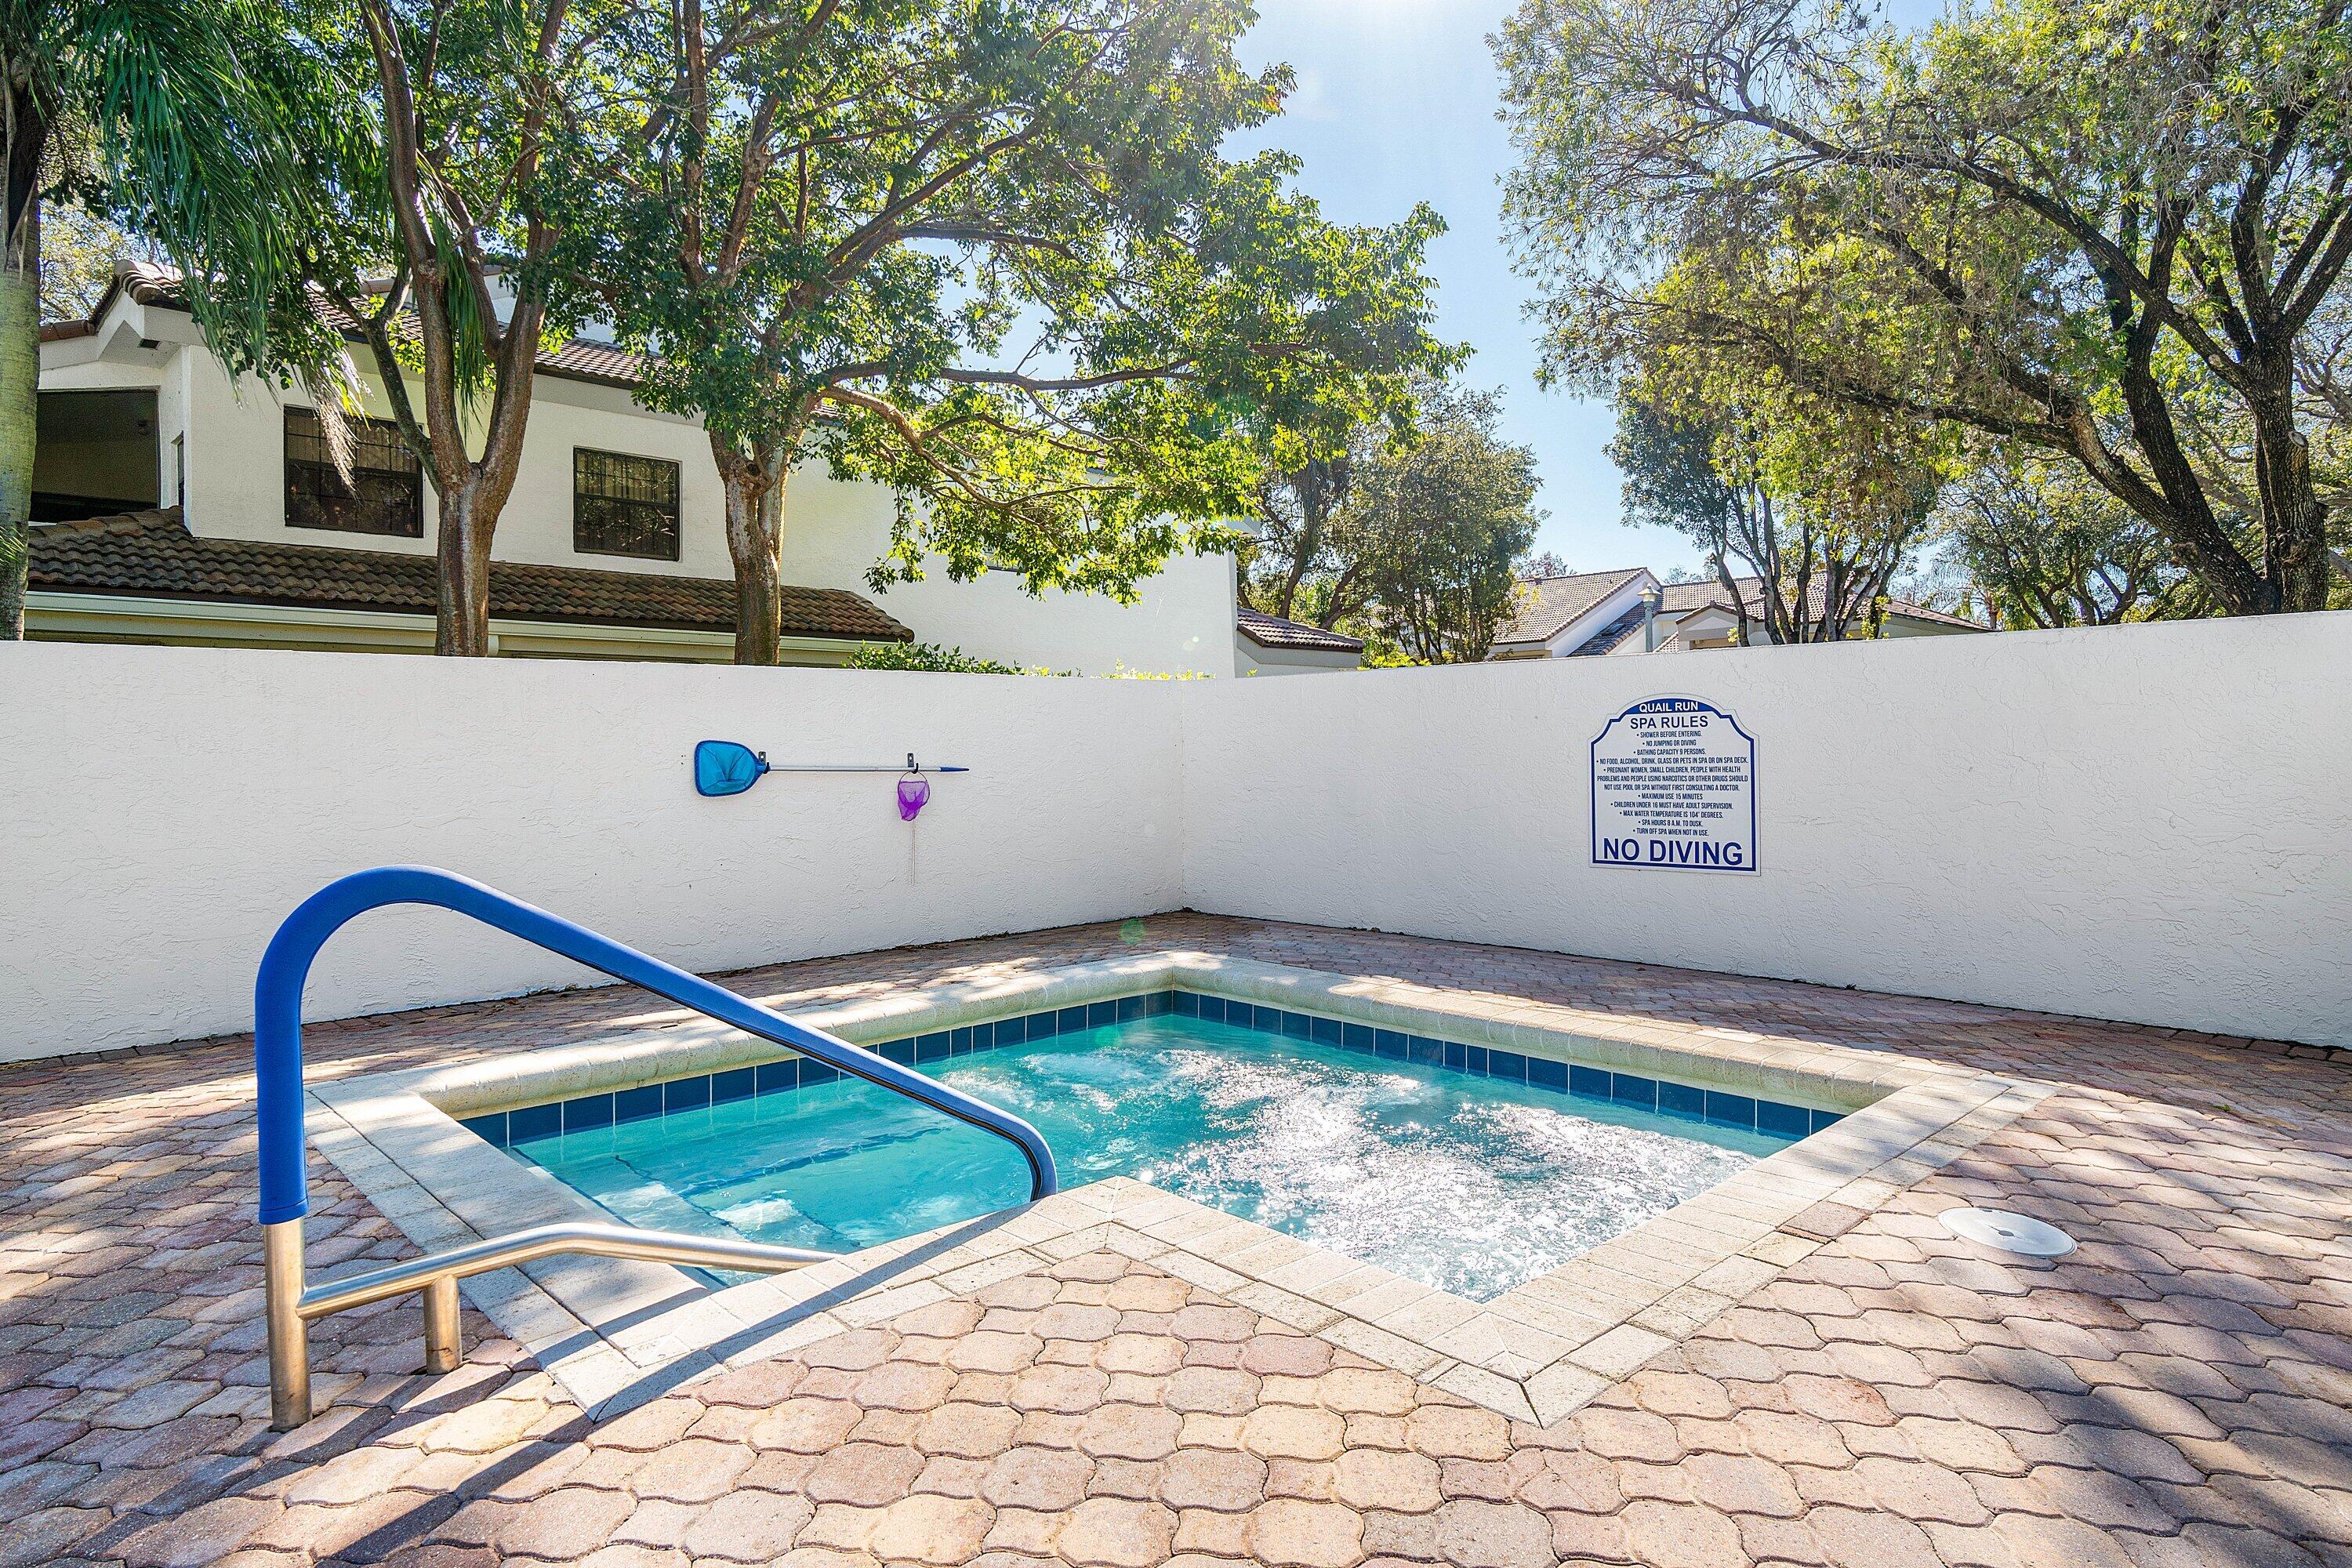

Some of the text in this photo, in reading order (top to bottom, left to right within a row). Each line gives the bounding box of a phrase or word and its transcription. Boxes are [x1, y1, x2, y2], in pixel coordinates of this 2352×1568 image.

[1639, 702, 1698, 713] QUAIL RUN
[1630, 716, 1708, 729] SPA RULES
[1604, 838, 1743, 866] NO DIVING
